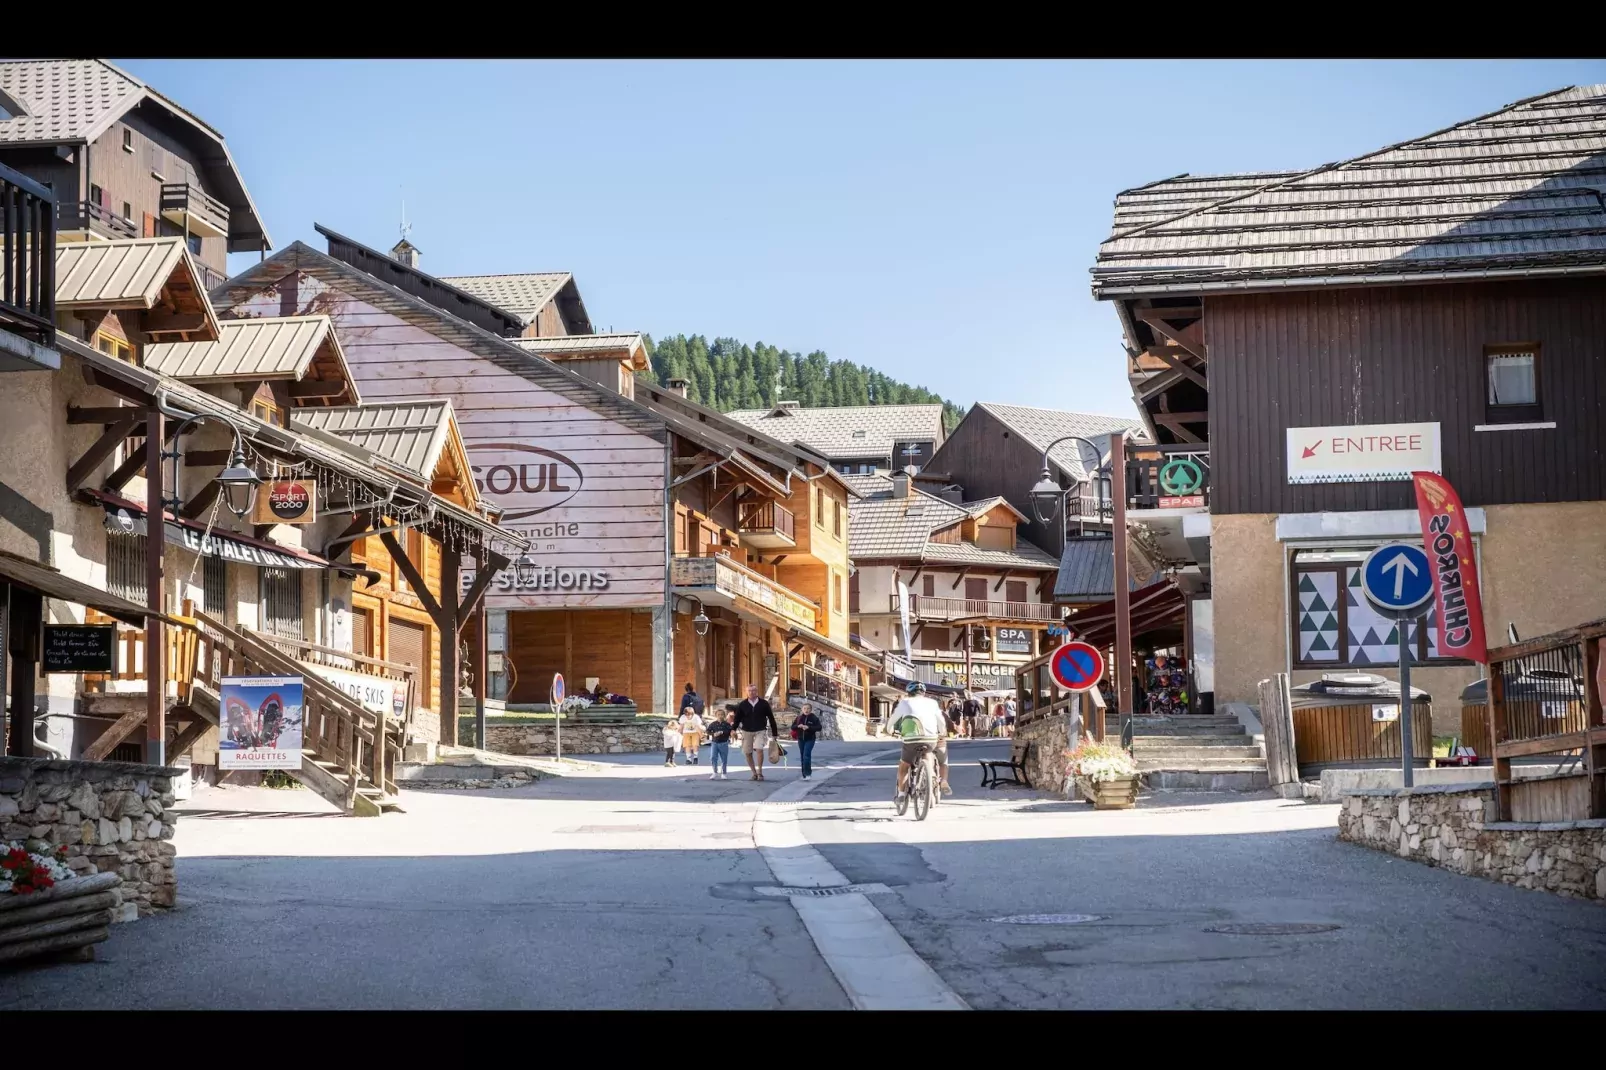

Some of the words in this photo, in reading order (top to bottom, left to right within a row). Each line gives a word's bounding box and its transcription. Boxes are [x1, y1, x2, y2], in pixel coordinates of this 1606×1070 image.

[1332, 434, 1422, 454] ENTREE
[272, 493, 306, 501] SPORT
[1160, 497, 1203, 506] SPAR
[275, 501, 303, 509] 2000
[512, 521, 579, 537] anche
[182, 528, 199, 550] LE
[202, 535, 260, 563] CHALET
[258, 550, 284, 566] DU
[496, 565, 609, 589] stations
[1000, 629, 1026, 639] SPA
[934, 663, 1028, 677] BOUANGER
[365, 687, 385, 705] SKIS
[235, 752, 287, 760] RAQUETTES
